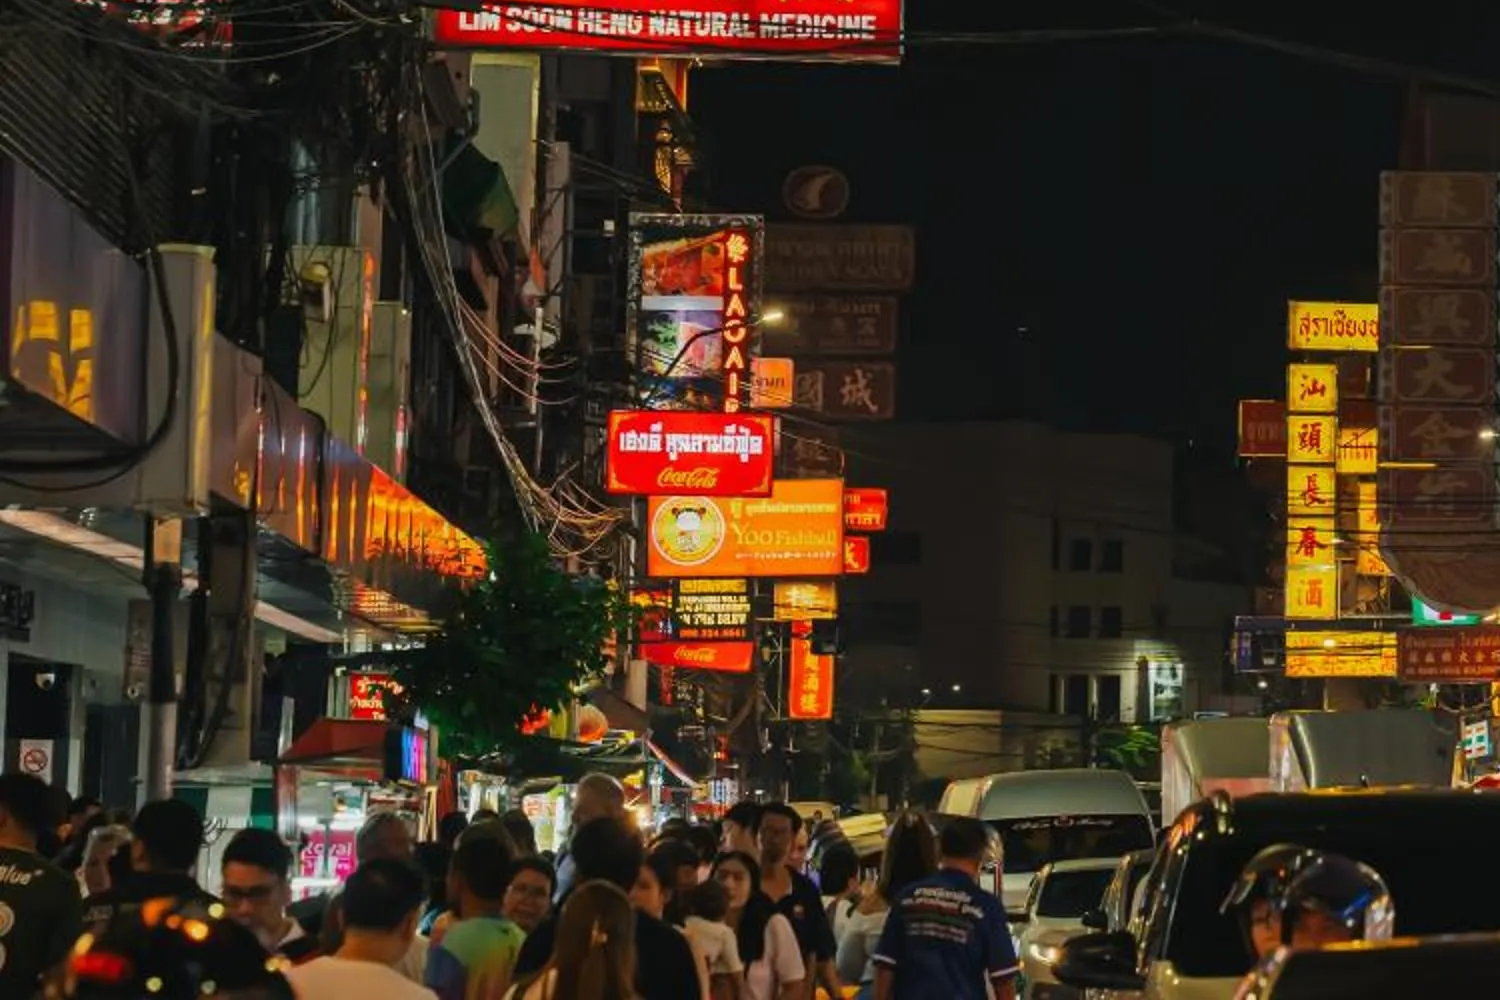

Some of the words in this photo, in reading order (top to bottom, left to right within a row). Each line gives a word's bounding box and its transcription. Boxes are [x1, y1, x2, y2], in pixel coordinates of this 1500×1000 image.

[459, 5, 500, 32] LIM
[506, 6, 573, 34] SOON
[577, 9, 643, 37] HENG
[649, 11, 756, 39] NATURAL
[759, 13, 877, 41] MEDICINE
